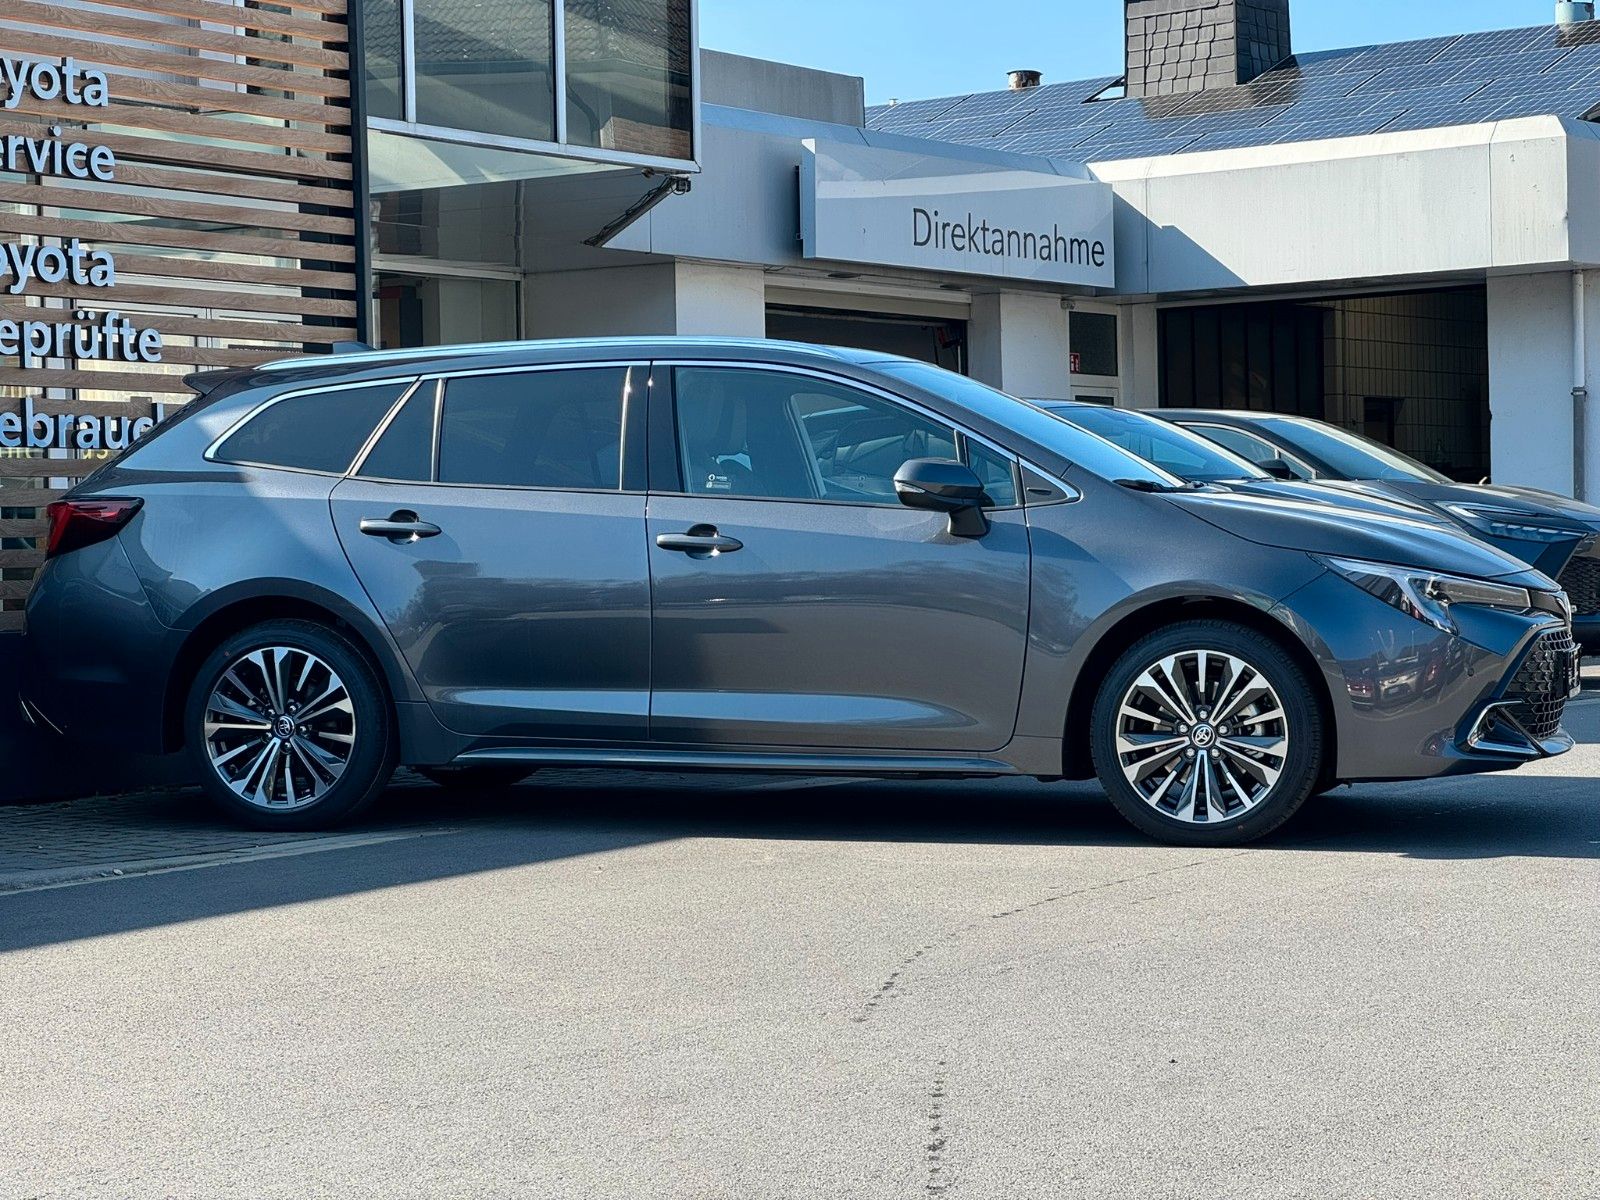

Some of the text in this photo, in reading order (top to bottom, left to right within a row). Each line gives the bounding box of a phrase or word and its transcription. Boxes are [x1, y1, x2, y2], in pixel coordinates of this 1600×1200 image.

[0, 56, 109, 109] yota
[0, 125, 116, 180] rvice
[912, 207, 1106, 267] Direktannahme
[0, 310, 163, 368] eprüfte
[0, 396, 165, 450] ebrauc
